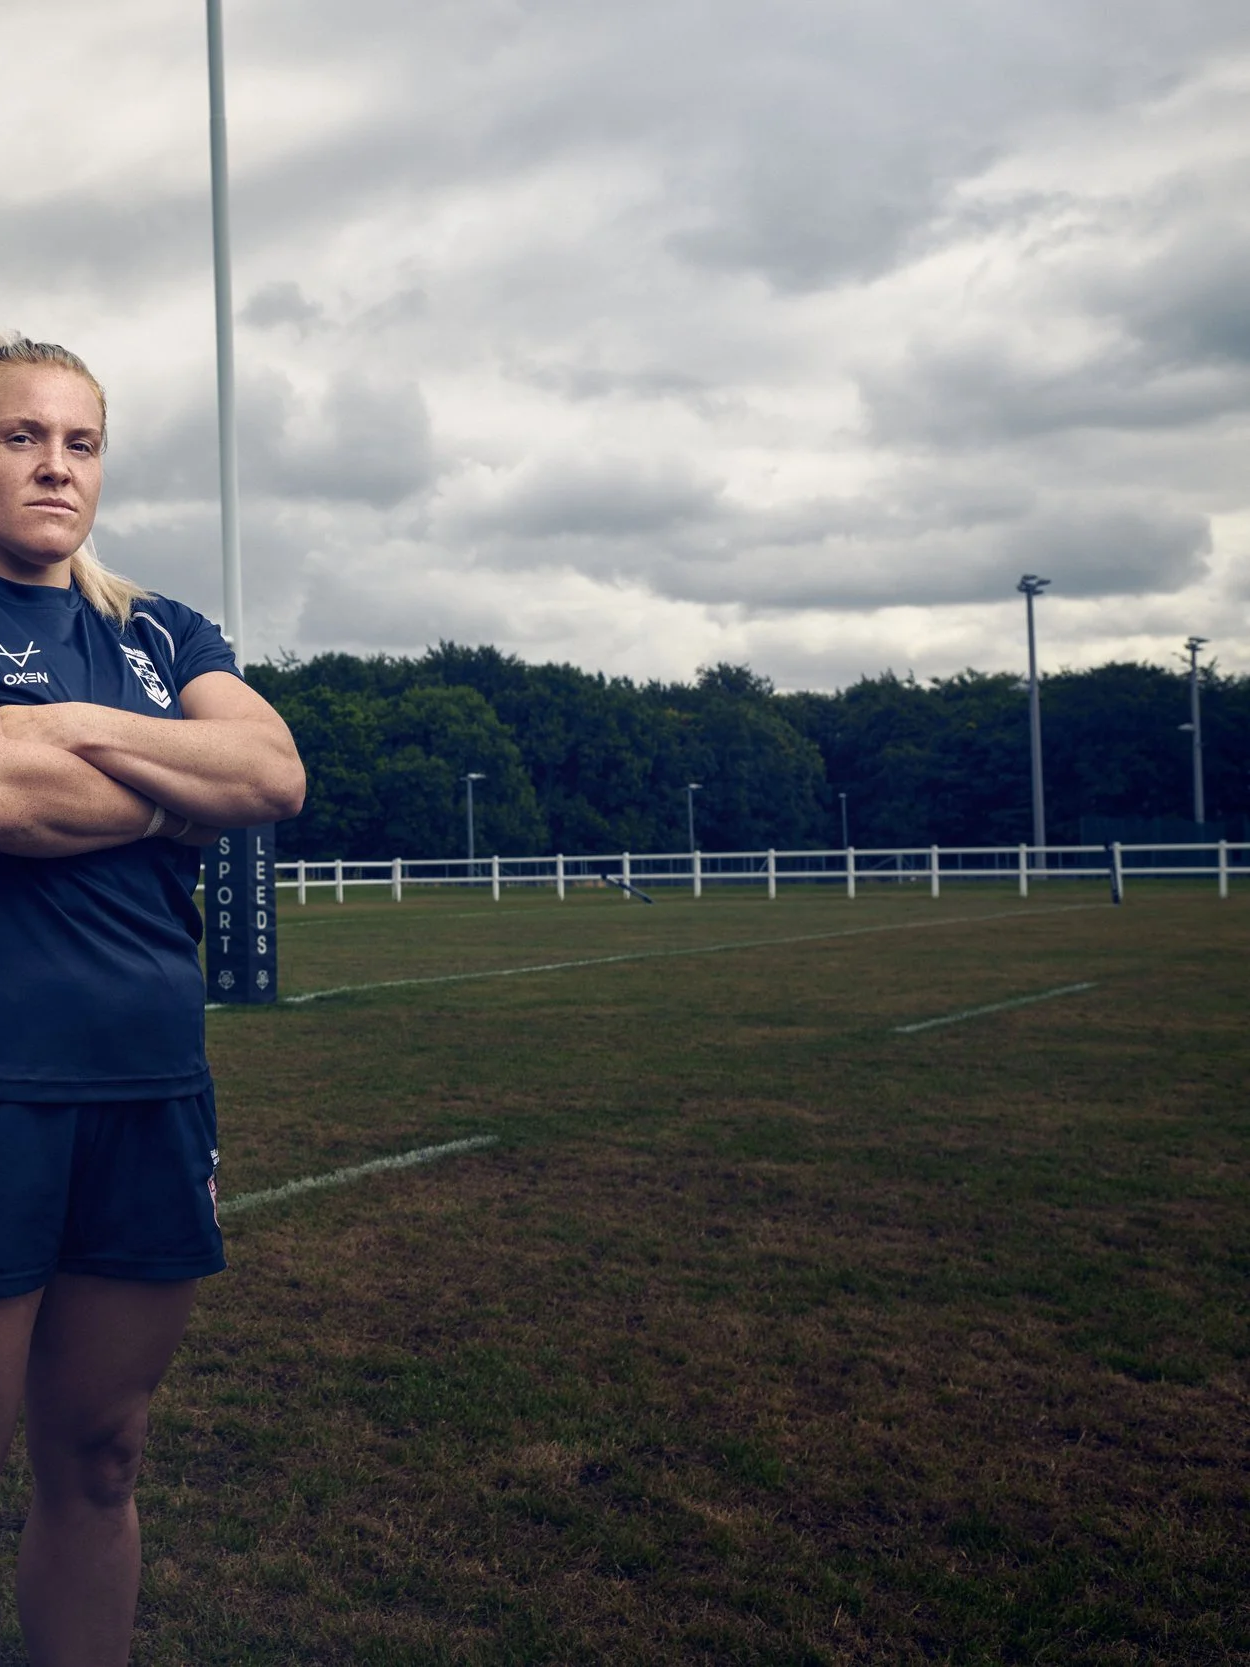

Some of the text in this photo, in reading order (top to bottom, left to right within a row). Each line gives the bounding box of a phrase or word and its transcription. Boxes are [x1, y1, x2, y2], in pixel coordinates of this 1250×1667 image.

[3, 671, 49, 686] OXEN
[217, 836, 233, 954] SPORT
[256, 835, 268, 955] LEEDS
